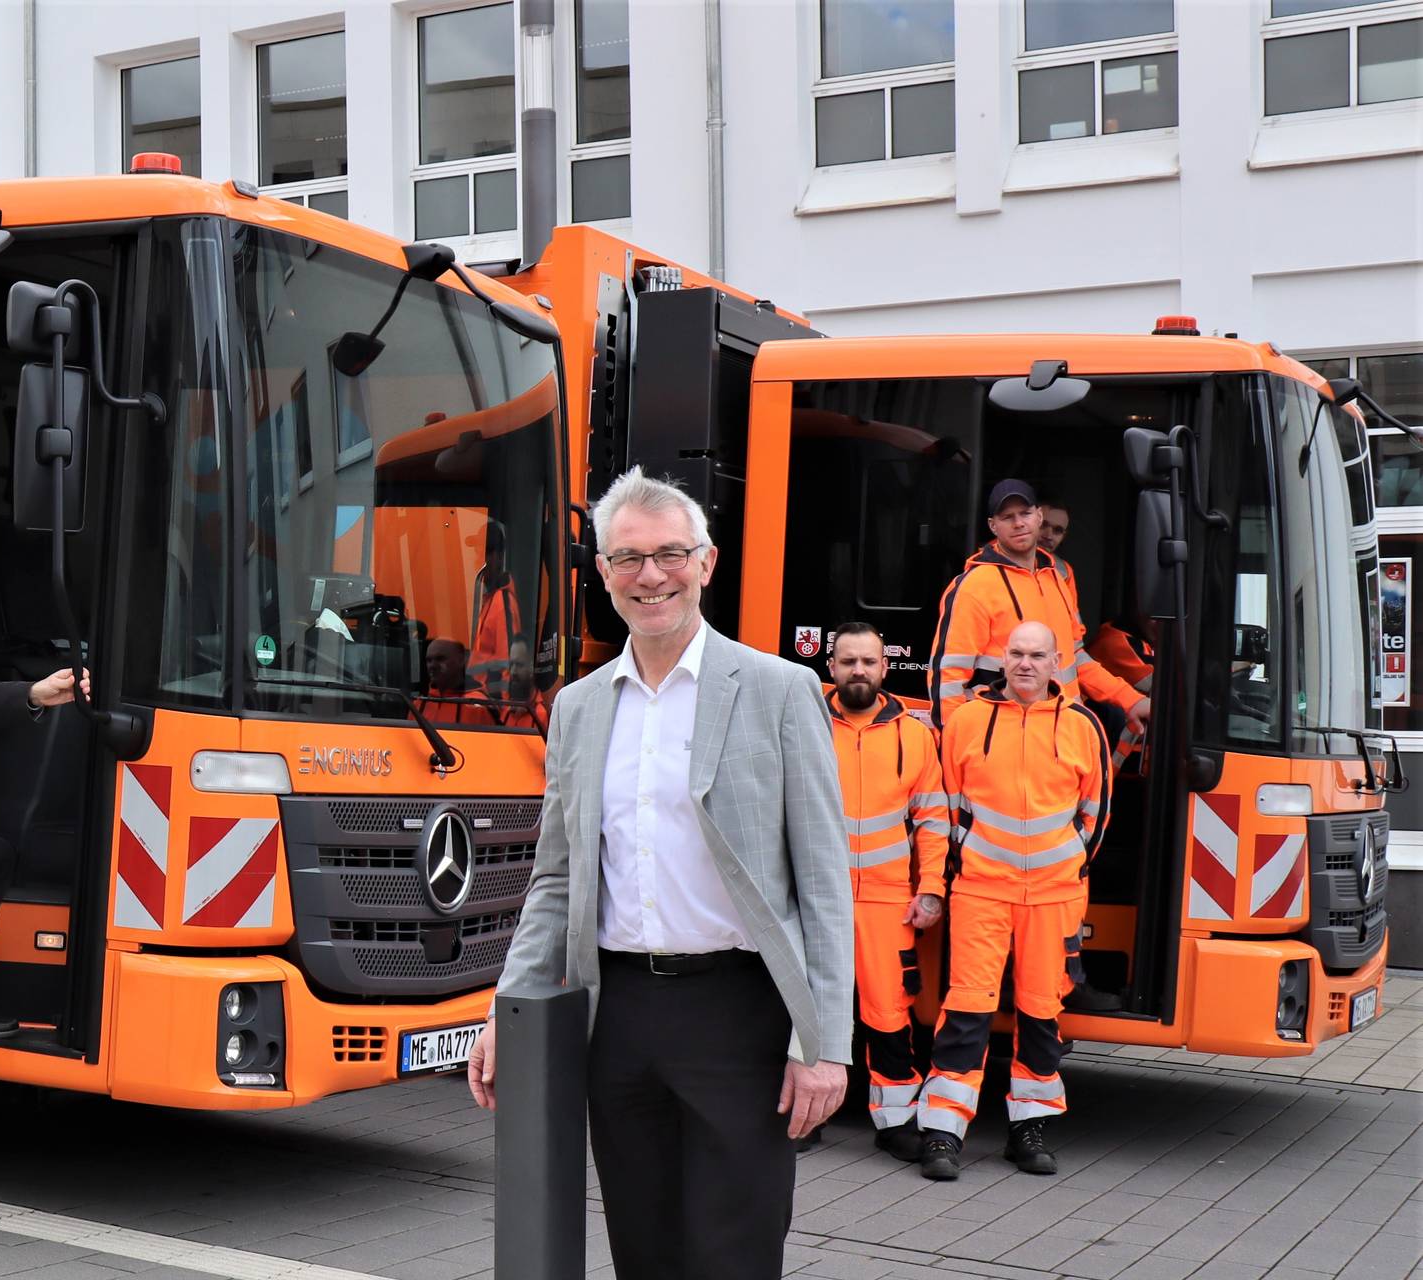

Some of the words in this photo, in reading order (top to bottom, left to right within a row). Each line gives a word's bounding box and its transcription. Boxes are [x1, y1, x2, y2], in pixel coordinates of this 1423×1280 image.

[262, 636, 270, 651] 4
[899, 663, 930, 671] DIENS
[298, 744, 393, 777] ENGINIUS
[411, 1037, 428, 1067] ME
